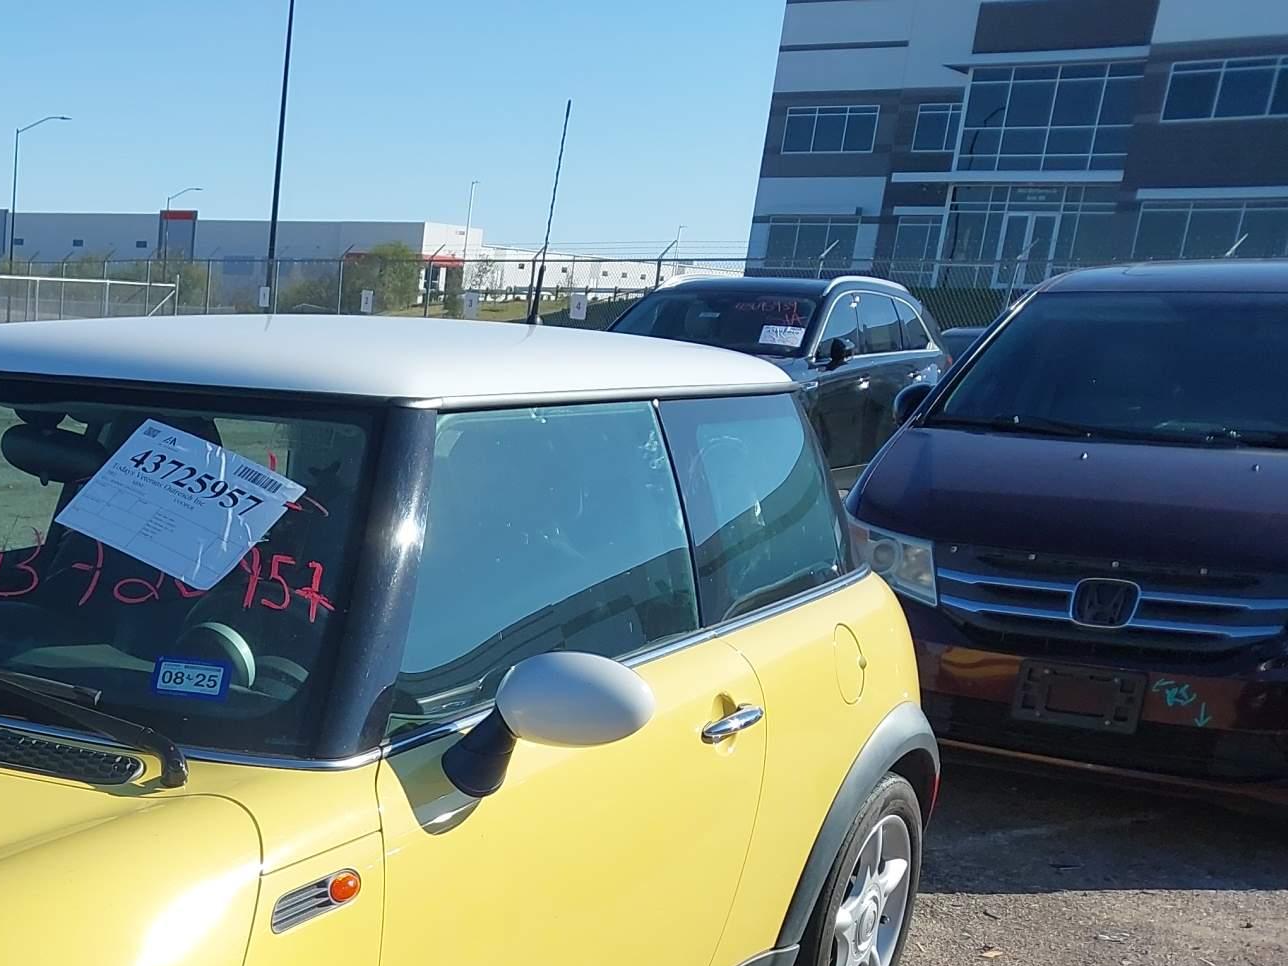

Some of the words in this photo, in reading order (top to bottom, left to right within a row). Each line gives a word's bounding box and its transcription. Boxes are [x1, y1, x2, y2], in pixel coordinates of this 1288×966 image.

[130, 450, 264, 516] 43725957
[162, 670, 185, 685] 08
[194, 673, 219, 689] 25
